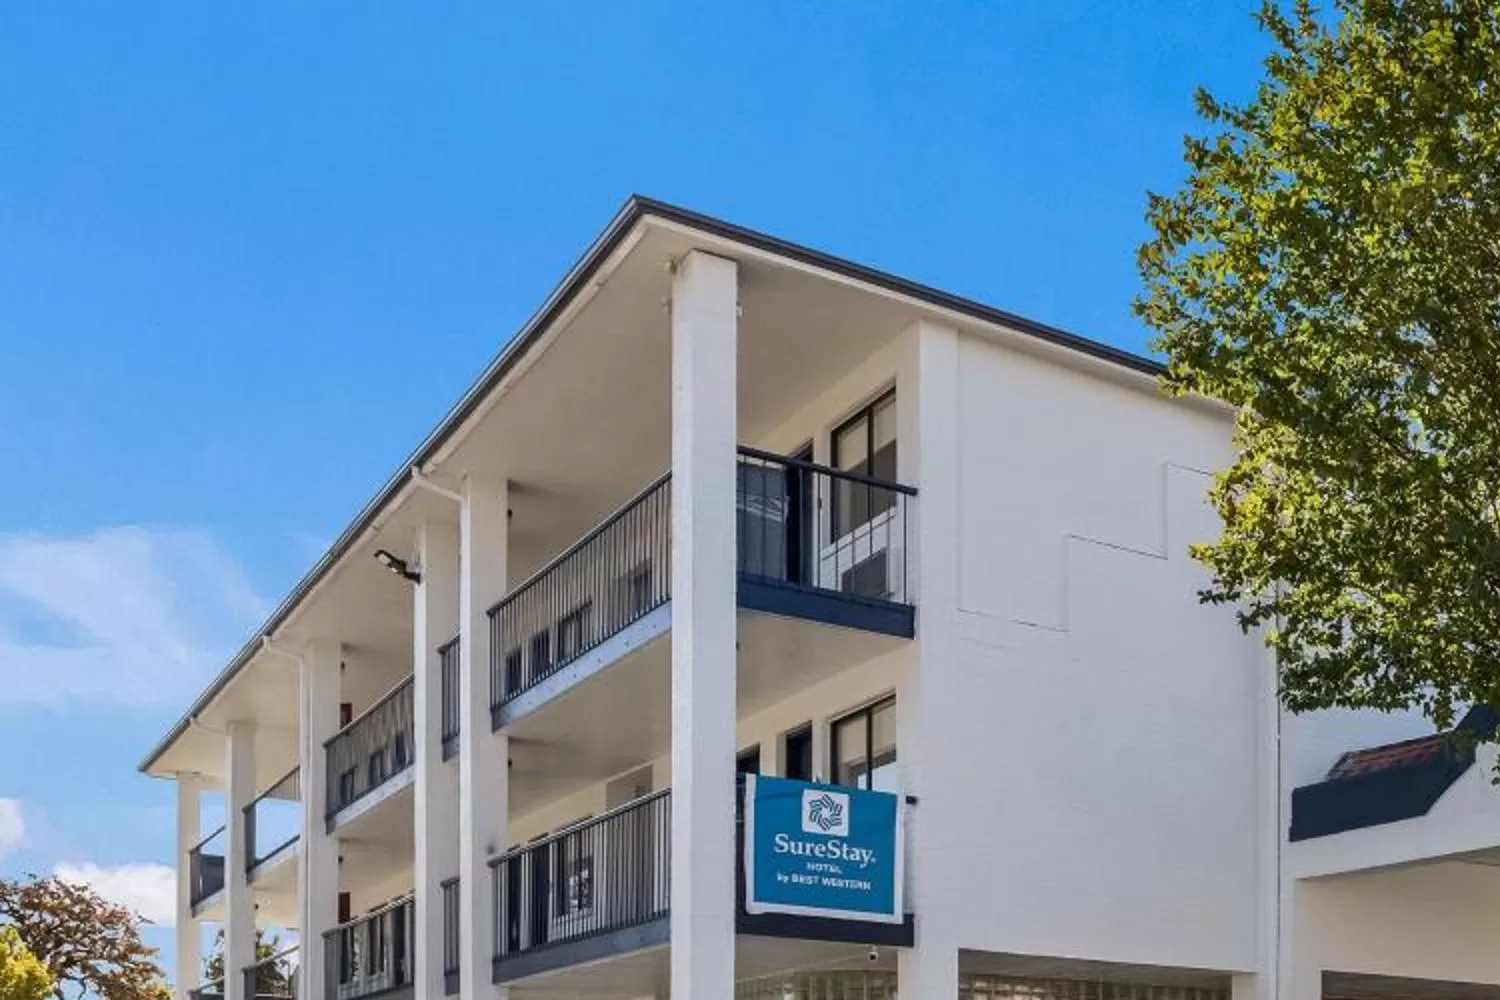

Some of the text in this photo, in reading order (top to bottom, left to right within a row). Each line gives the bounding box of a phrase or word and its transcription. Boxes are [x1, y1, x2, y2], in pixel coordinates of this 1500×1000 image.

[806, 862, 842, 874] HOTEL
[777, 872, 871, 890] by BEST WESTERN
